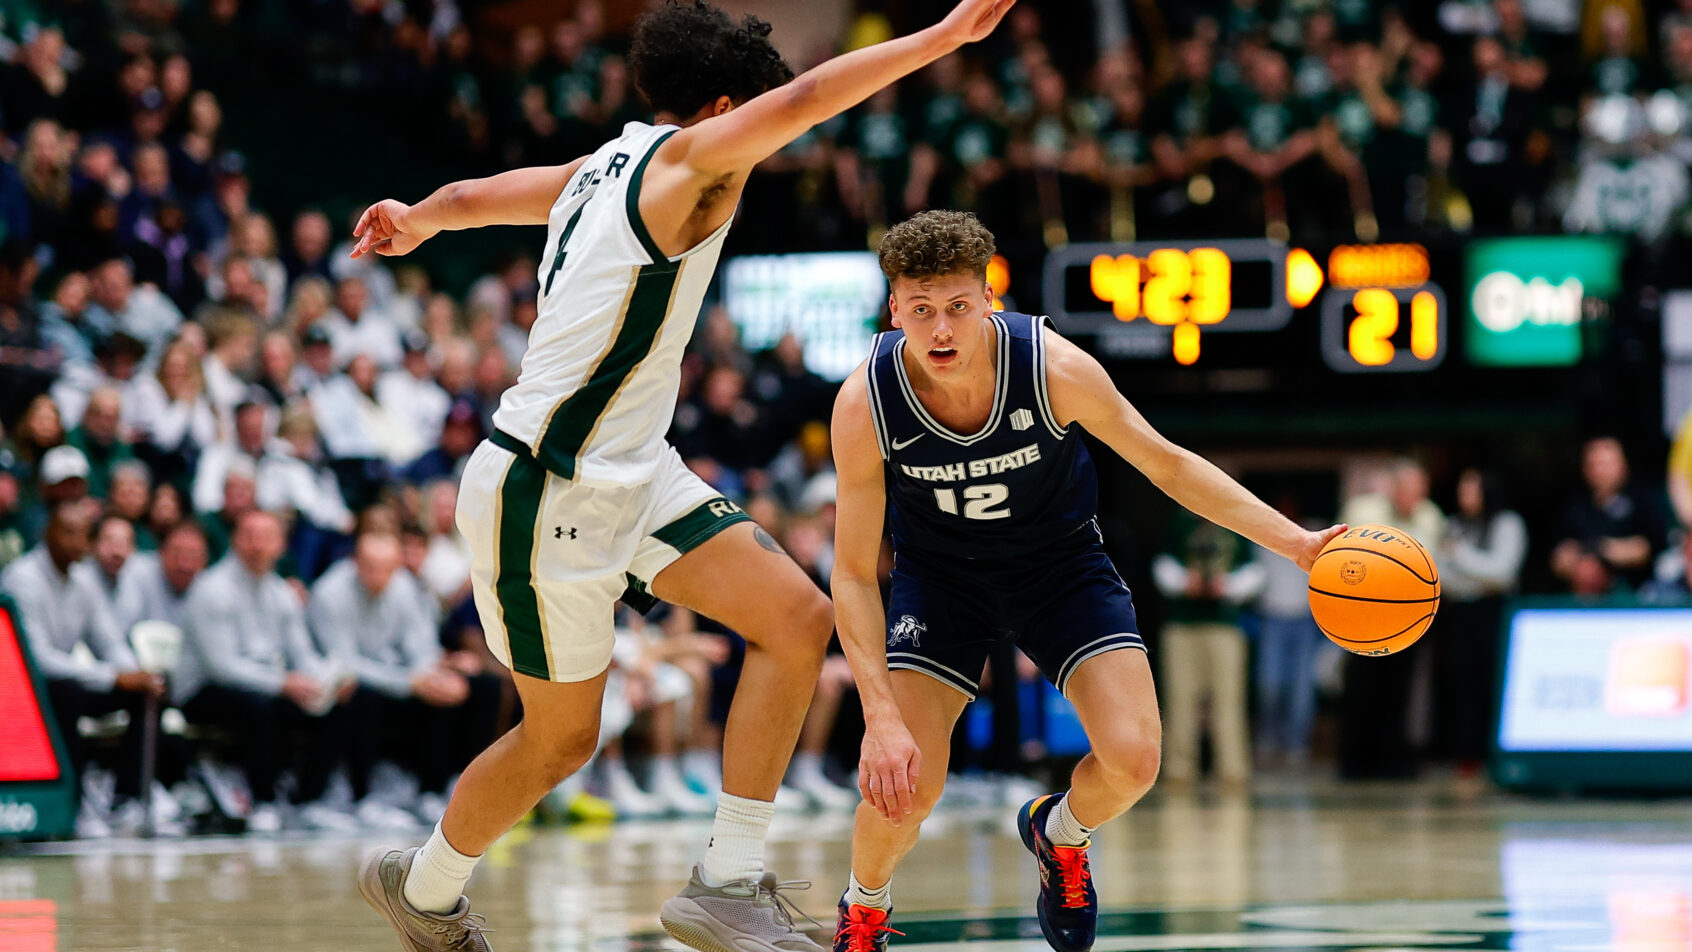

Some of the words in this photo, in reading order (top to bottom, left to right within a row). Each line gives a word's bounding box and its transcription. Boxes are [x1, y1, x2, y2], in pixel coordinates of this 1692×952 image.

[1173, 323, 1201, 366] 1
[1348, 289, 1438, 366] 21
[900, 462, 967, 482] UTAH
[968, 442, 1042, 478] STATE
[933, 483, 1012, 520] 12
[1343, 529, 1396, 543] EVO
